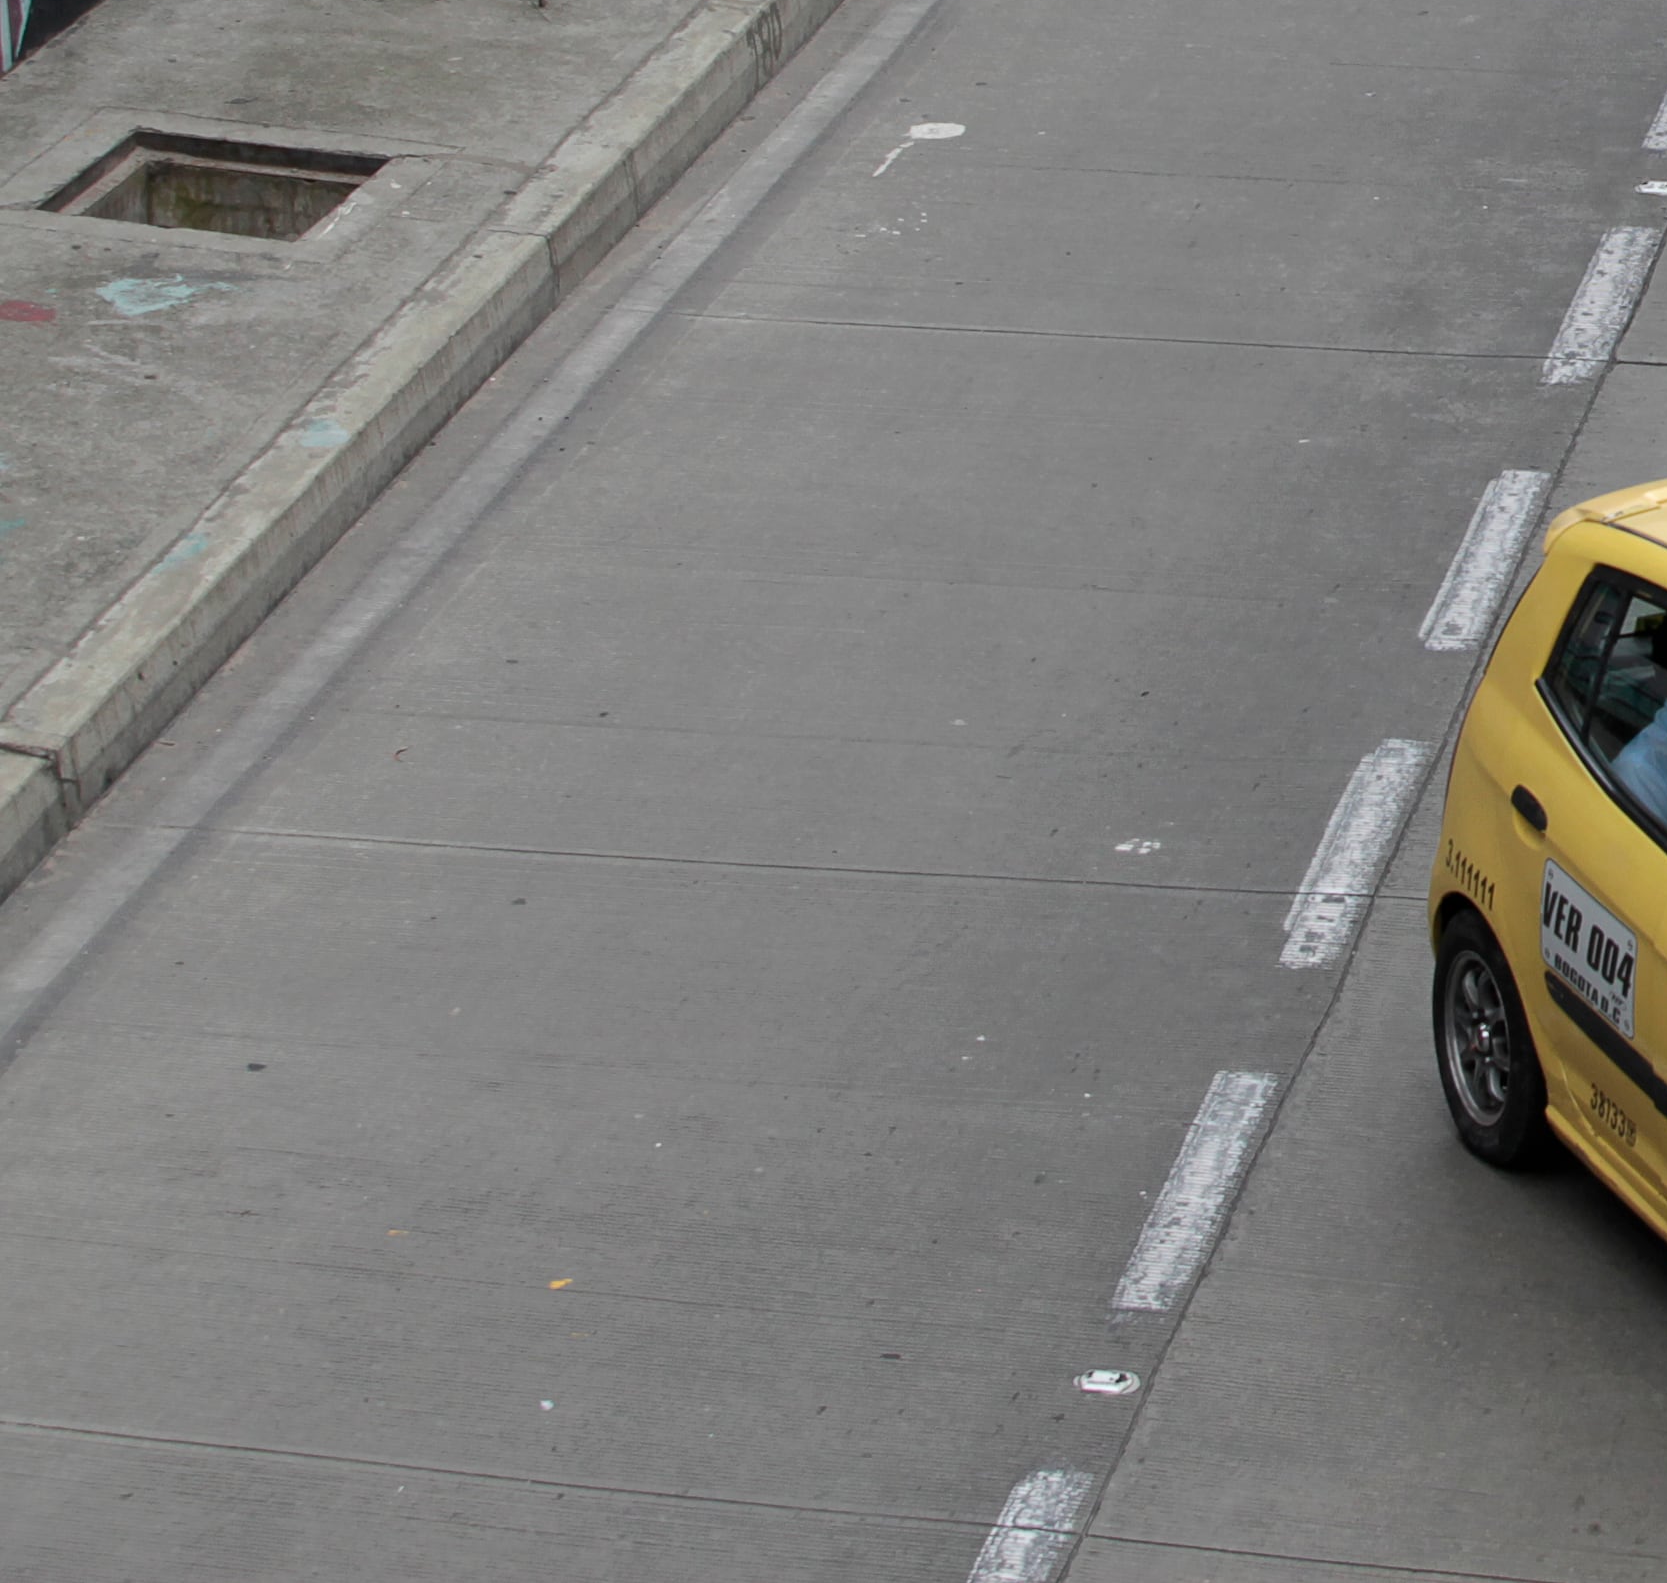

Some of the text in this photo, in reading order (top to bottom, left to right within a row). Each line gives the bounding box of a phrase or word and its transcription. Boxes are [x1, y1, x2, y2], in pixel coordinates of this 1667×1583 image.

[1542, 881, 1635, 1000] VER 004
[1553, 952, 1599, 1007] BOGOTA
